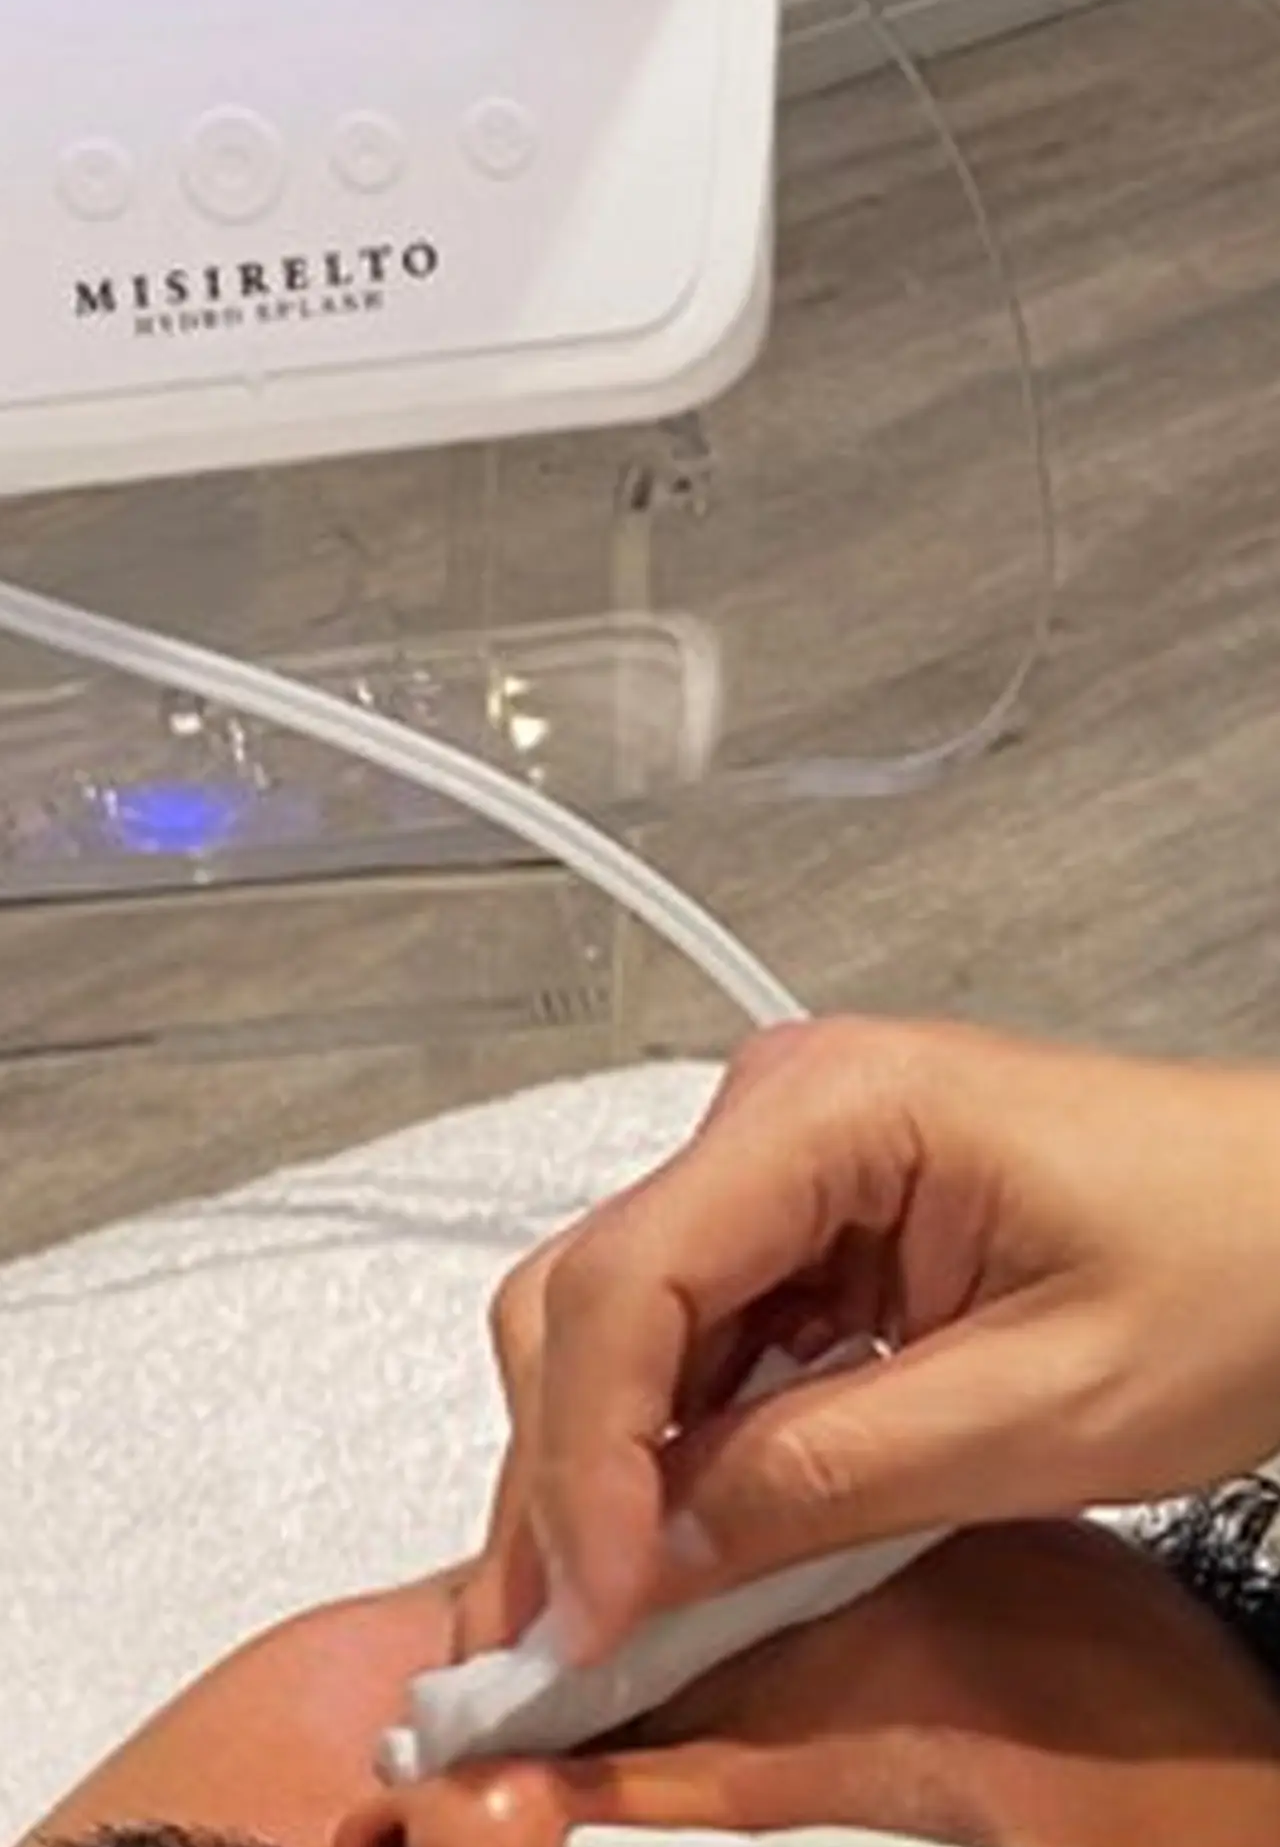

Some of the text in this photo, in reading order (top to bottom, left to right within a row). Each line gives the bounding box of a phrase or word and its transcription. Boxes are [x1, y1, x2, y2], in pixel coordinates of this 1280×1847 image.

[74, 241, 438, 316] MISIRELTO
[133, 291, 384, 336] HYDRO SPLASH
